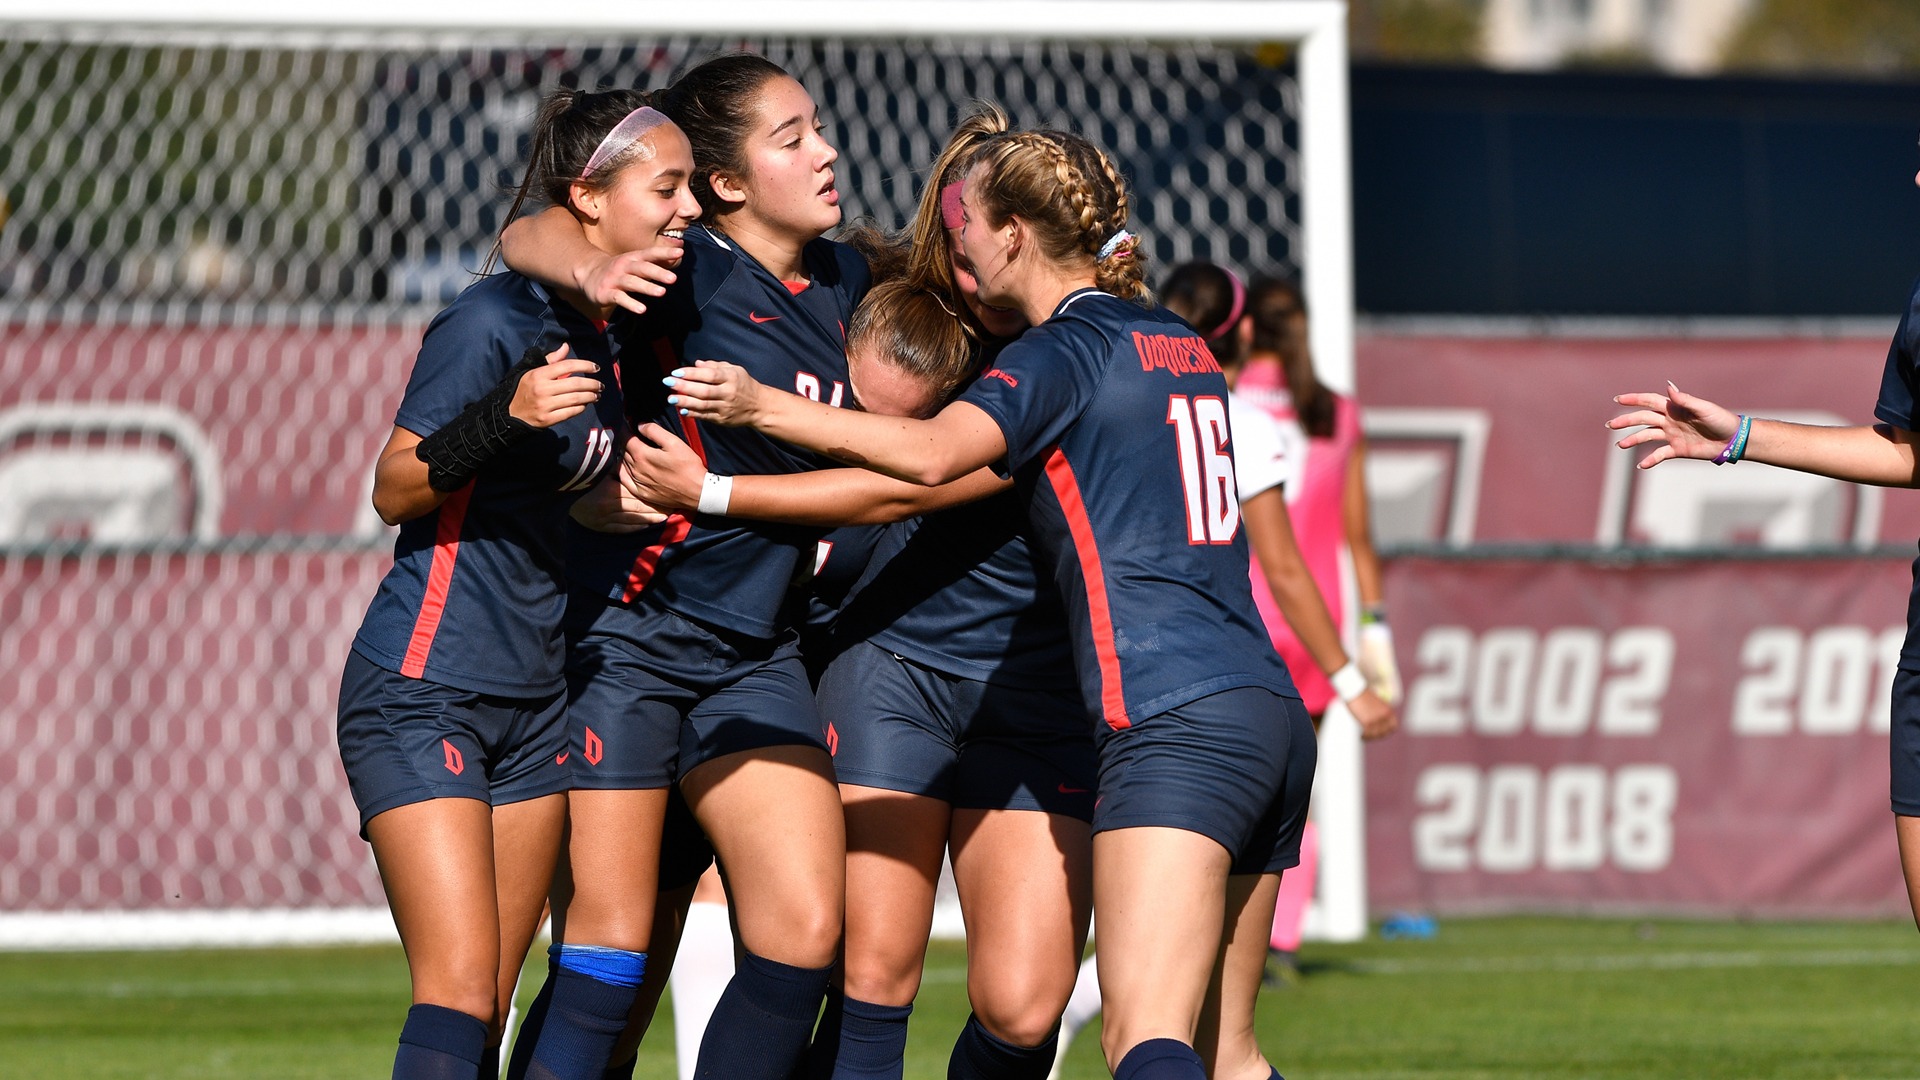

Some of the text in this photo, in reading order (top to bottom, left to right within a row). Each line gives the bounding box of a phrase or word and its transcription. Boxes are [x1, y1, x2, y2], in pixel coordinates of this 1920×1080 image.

[1131, 331, 1223, 377] DUQUESN
[557, 427, 615, 492] 12
[1166, 394, 1241, 545] 16
[1402, 627, 1677, 735] 2002
[1733, 627, 1907, 735] 201
[1410, 765, 1679, 872] 2008
